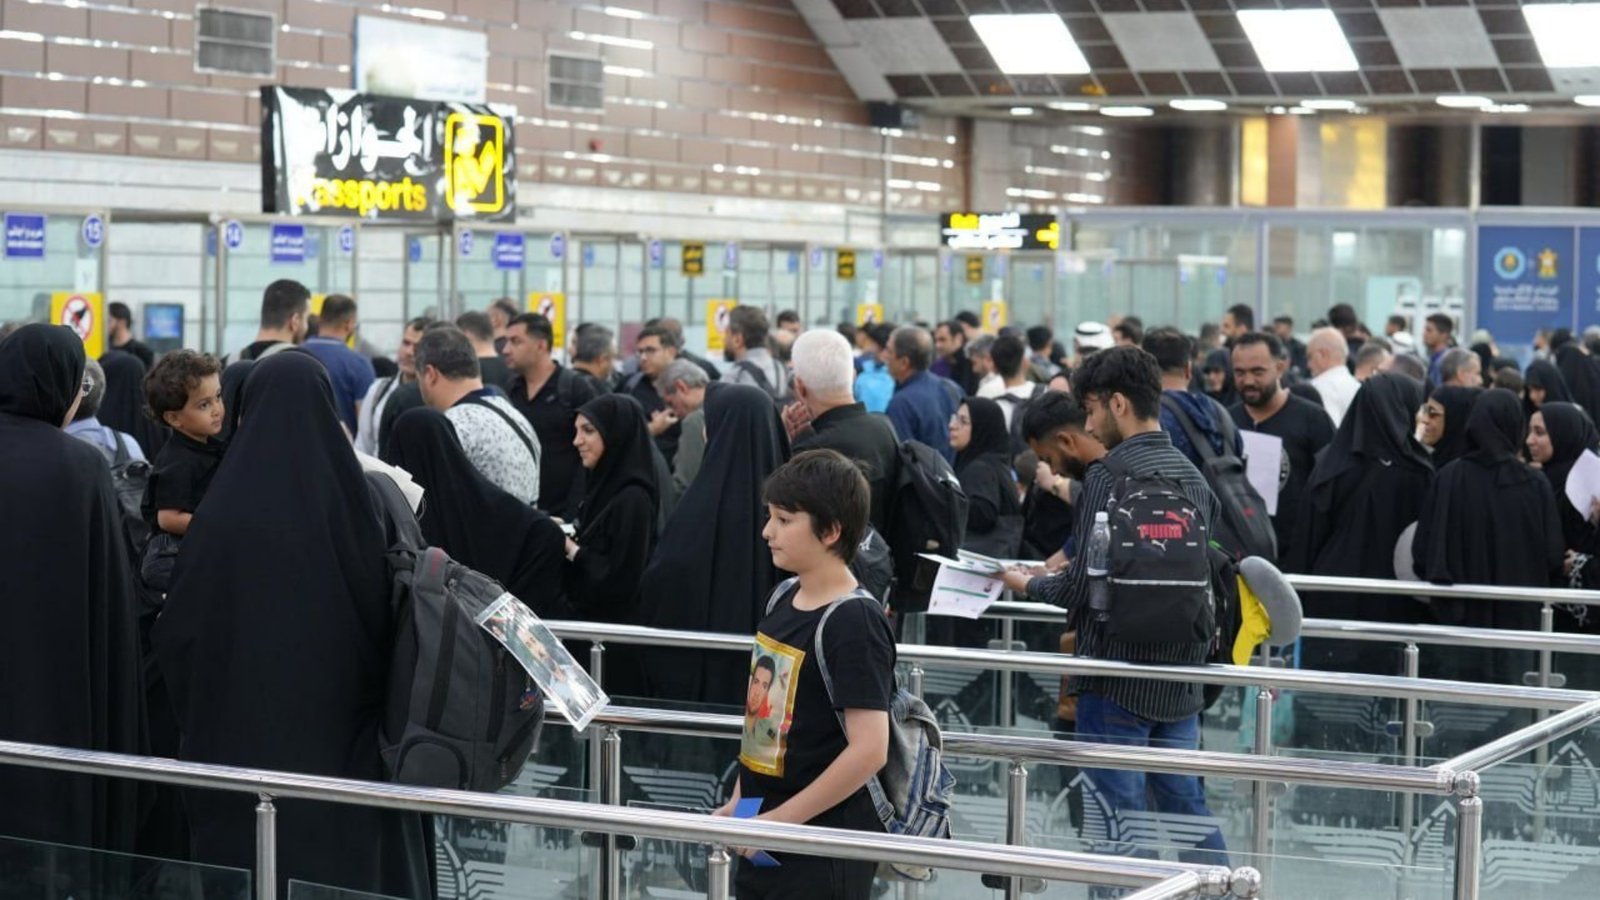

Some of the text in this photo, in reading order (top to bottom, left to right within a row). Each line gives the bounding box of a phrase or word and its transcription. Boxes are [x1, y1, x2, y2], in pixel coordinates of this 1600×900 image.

[301, 103, 432, 176] الجوازا
[297, 177, 427, 216] assports
[87, 221, 102, 241] 15
[1139, 524, 1183, 539] PUMA
